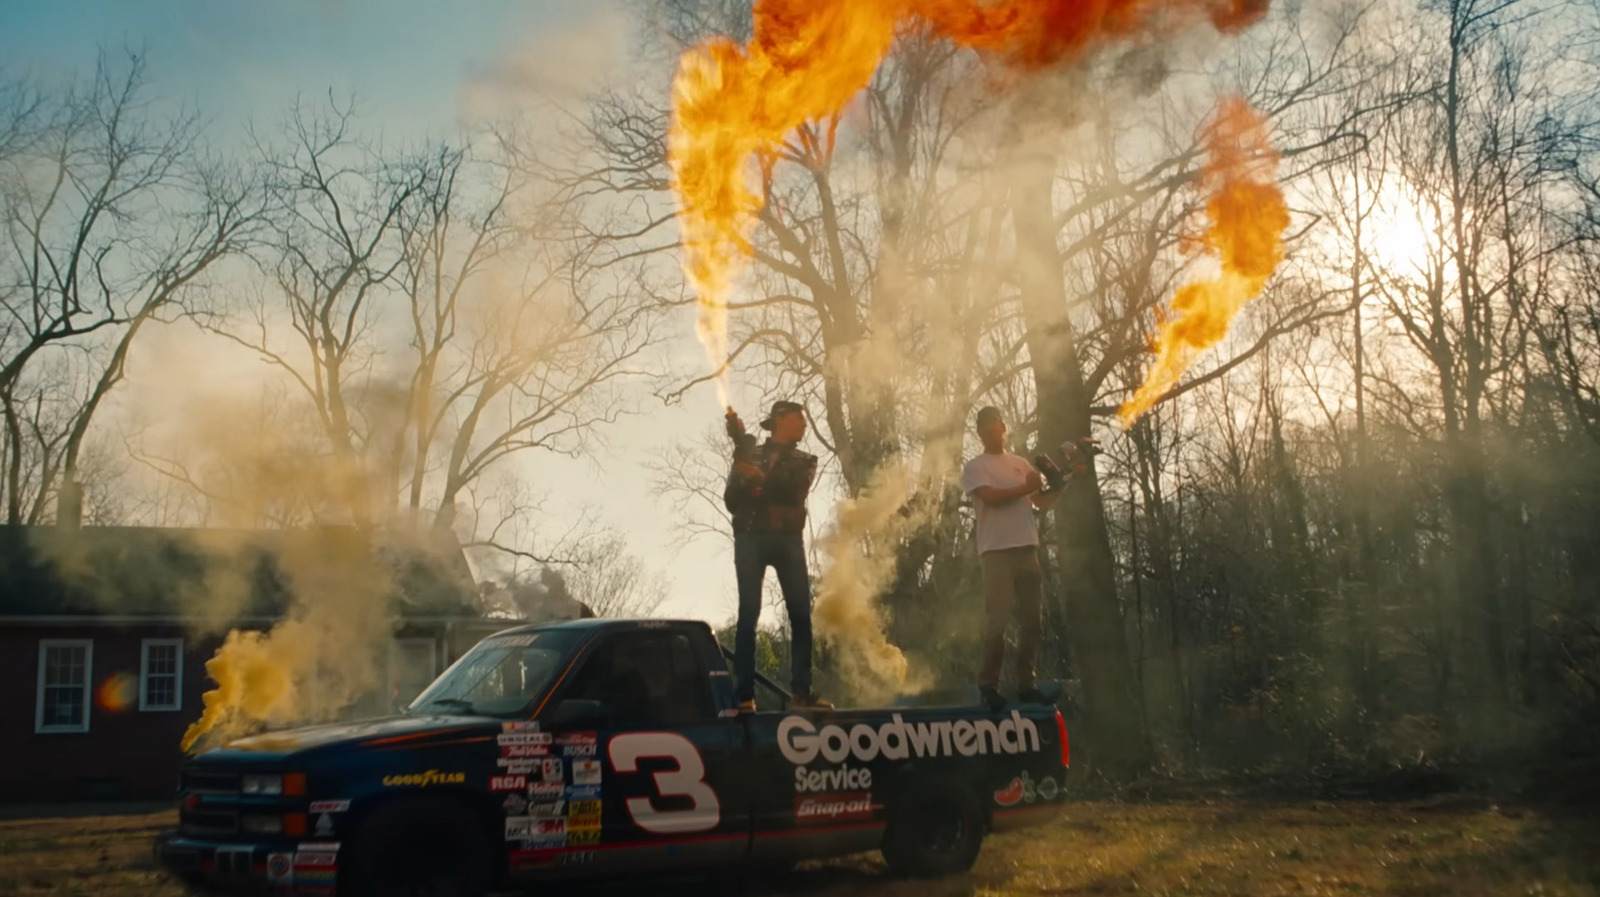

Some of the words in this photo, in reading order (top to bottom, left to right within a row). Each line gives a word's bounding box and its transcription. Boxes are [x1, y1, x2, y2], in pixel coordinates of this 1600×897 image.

[777, 710, 1040, 764] Goodwrench
[563, 744, 598, 757] BUSCH
[382, 769, 465, 788] GOODYEAR
[491, 776, 526, 790] RCA
[606, 731, 721, 834] 3
[795, 762, 872, 792] Service
[797, 792, 872, 818] Snap-on
